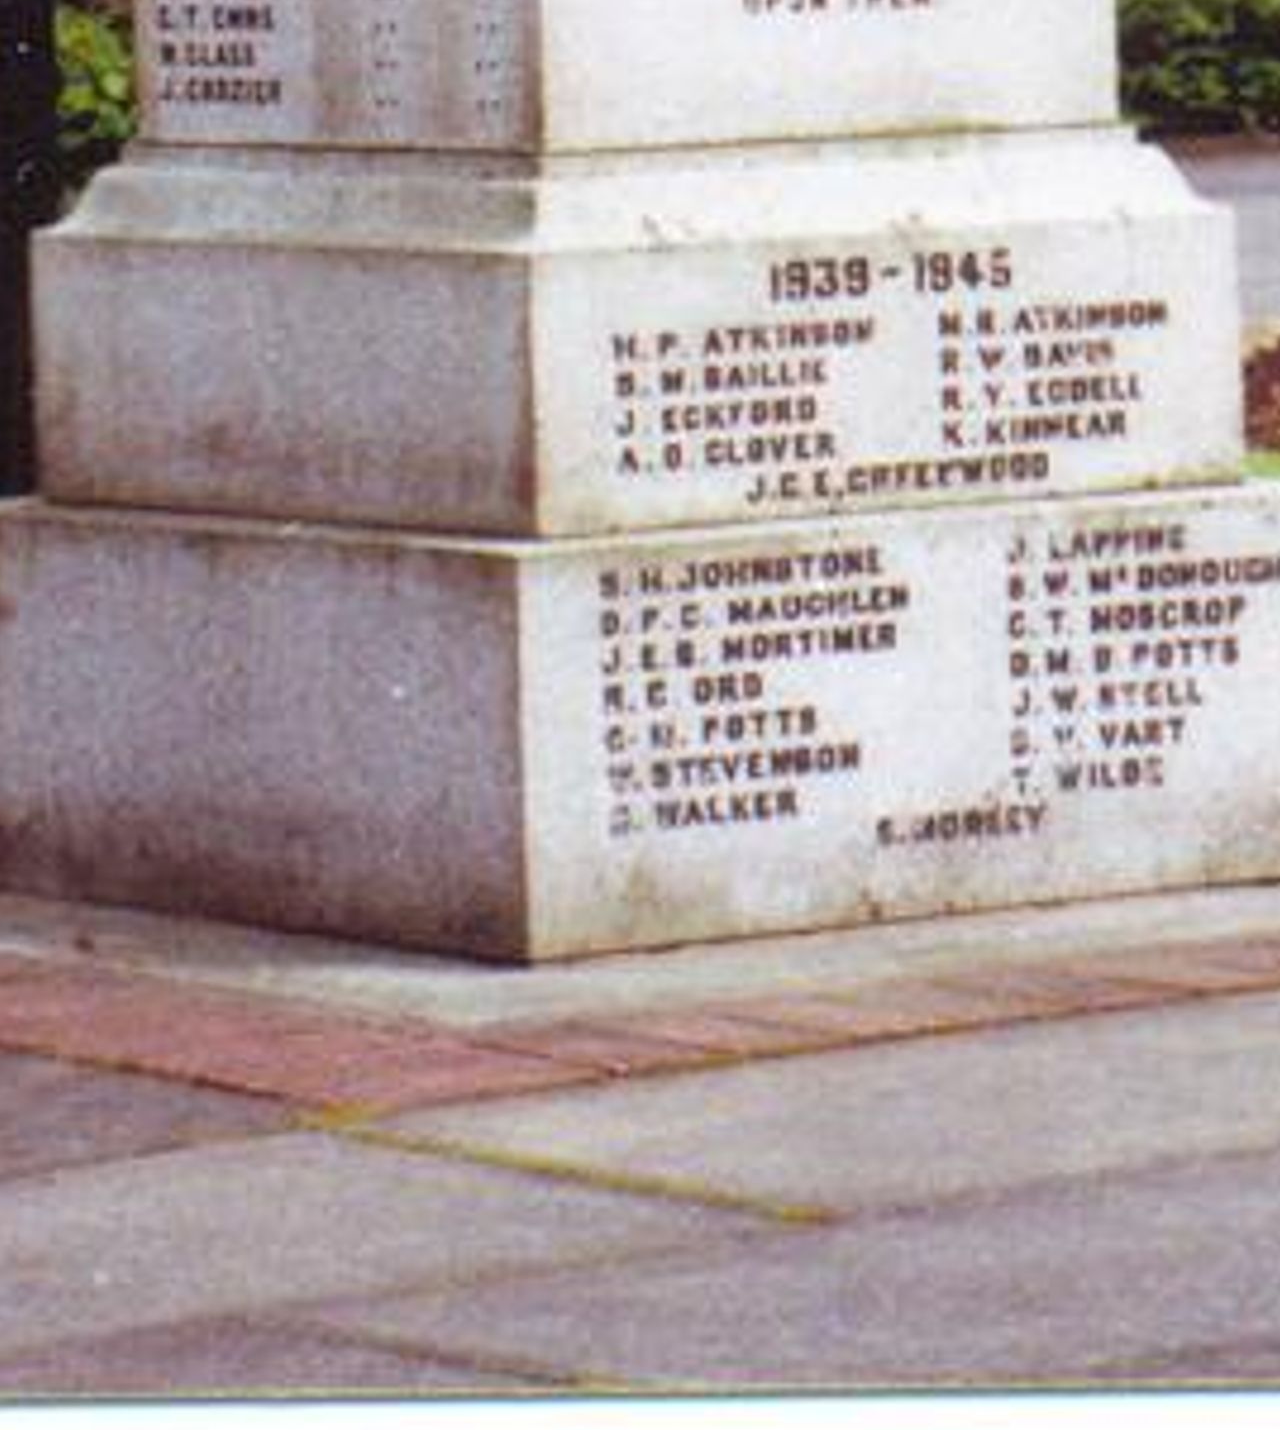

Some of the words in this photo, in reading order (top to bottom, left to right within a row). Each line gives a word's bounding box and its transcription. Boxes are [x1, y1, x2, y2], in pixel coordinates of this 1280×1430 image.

[705, 316, 875, 354] ATKINSON
[1014, 299, 1168, 334] ATKINSON
[704, 359, 830, 392] BAILLIE
[676, 548, 884, 592] JOHNSTONE
[1090, 596, 1248, 635] MOSCROP
[722, 622, 899, 663] MORTIMER
[1132, 636, 1240, 668] POTTS
[694, 671, 764, 705] ORD
[703, 706, 816, 743] POTTS
[650, 743, 862, 789] STEVENSON
[654, 790, 797, 827] WALKER
